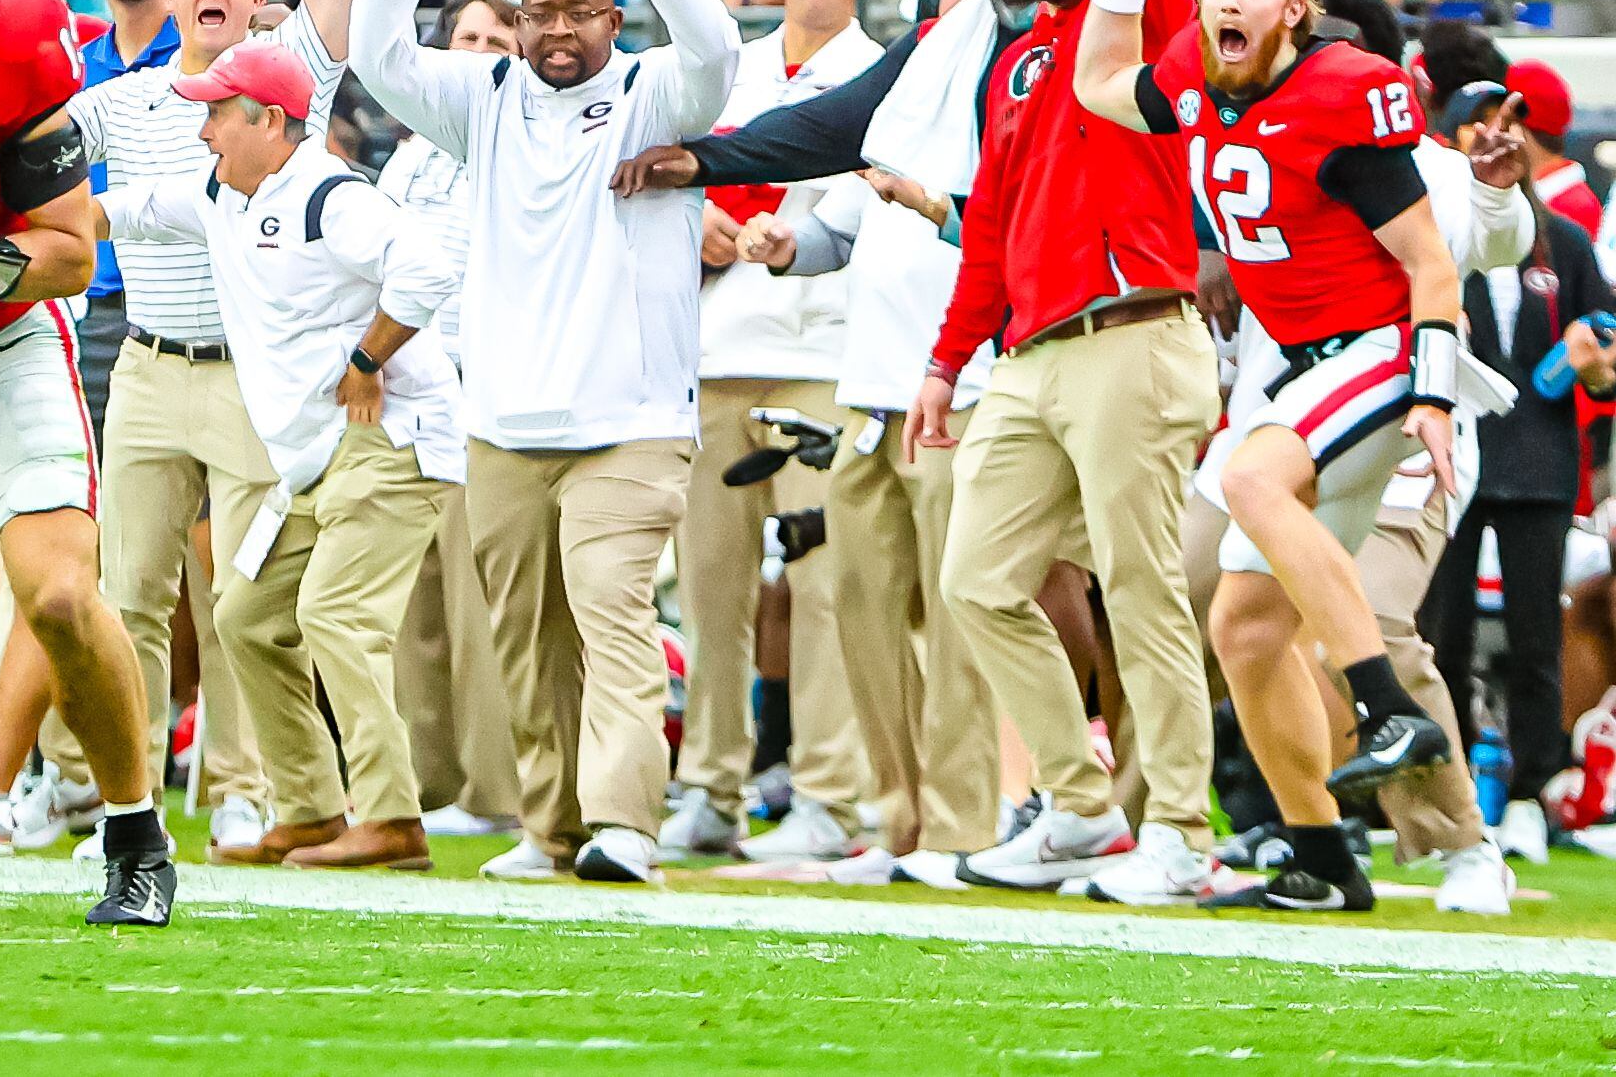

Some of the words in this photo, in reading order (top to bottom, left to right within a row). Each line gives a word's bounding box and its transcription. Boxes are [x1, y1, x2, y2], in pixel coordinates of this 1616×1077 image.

[583, 102, 613, 119] G
[1366, 82, 1413, 138] 12
[1188, 135, 1292, 262] 12
[261, 216, 280, 236] G
